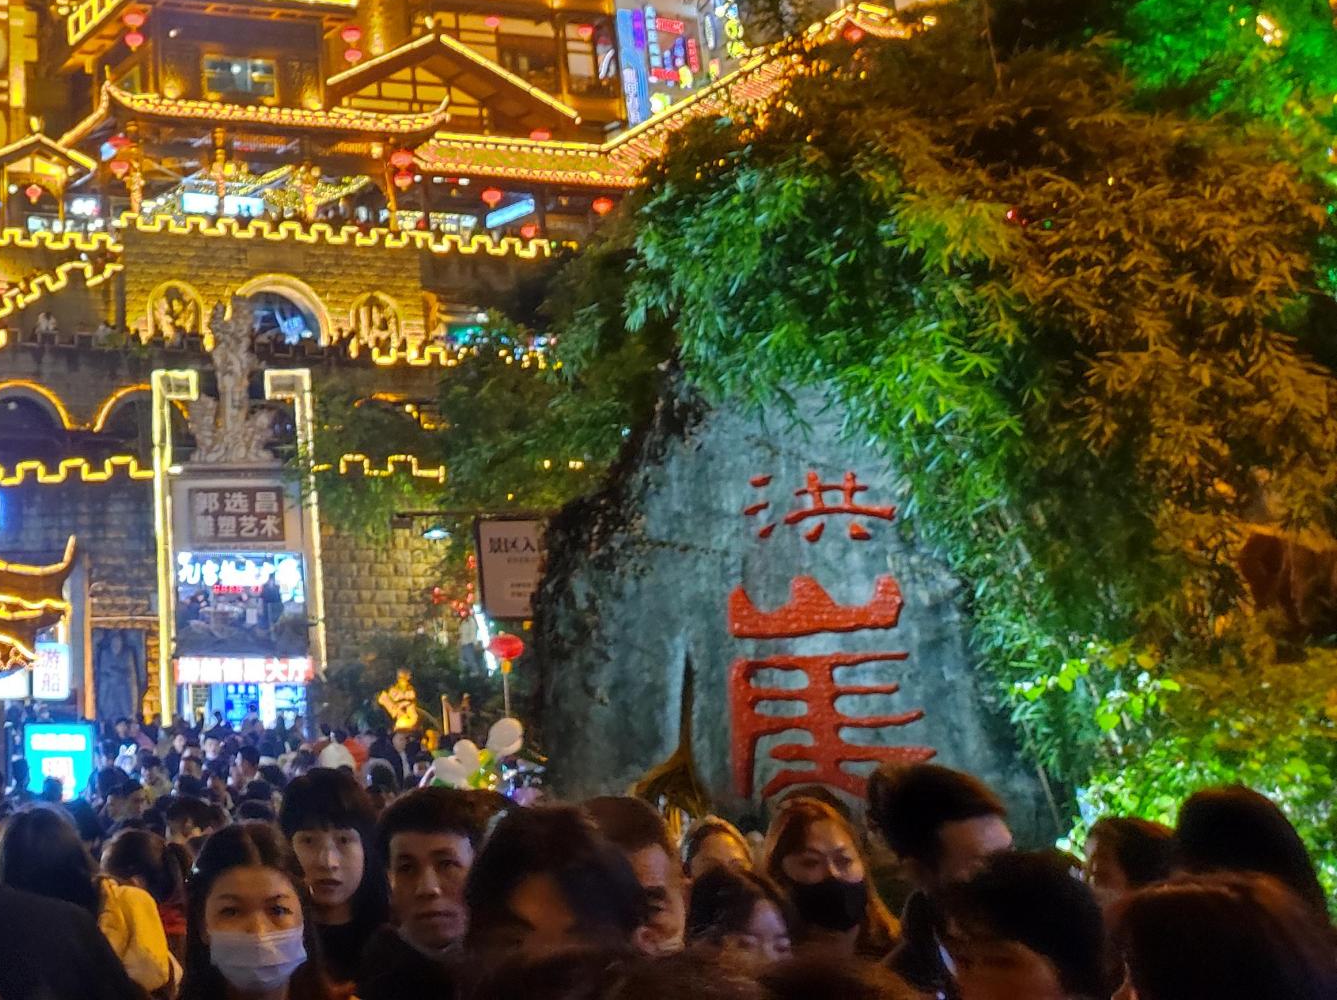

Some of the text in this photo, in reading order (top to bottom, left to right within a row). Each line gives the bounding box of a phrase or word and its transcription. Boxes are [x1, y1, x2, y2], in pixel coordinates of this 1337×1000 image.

[193, 491, 279, 514] 郭选昌
[194, 515, 281, 538] 雕塑艺术
[487, 536, 540, 554] 景区入
